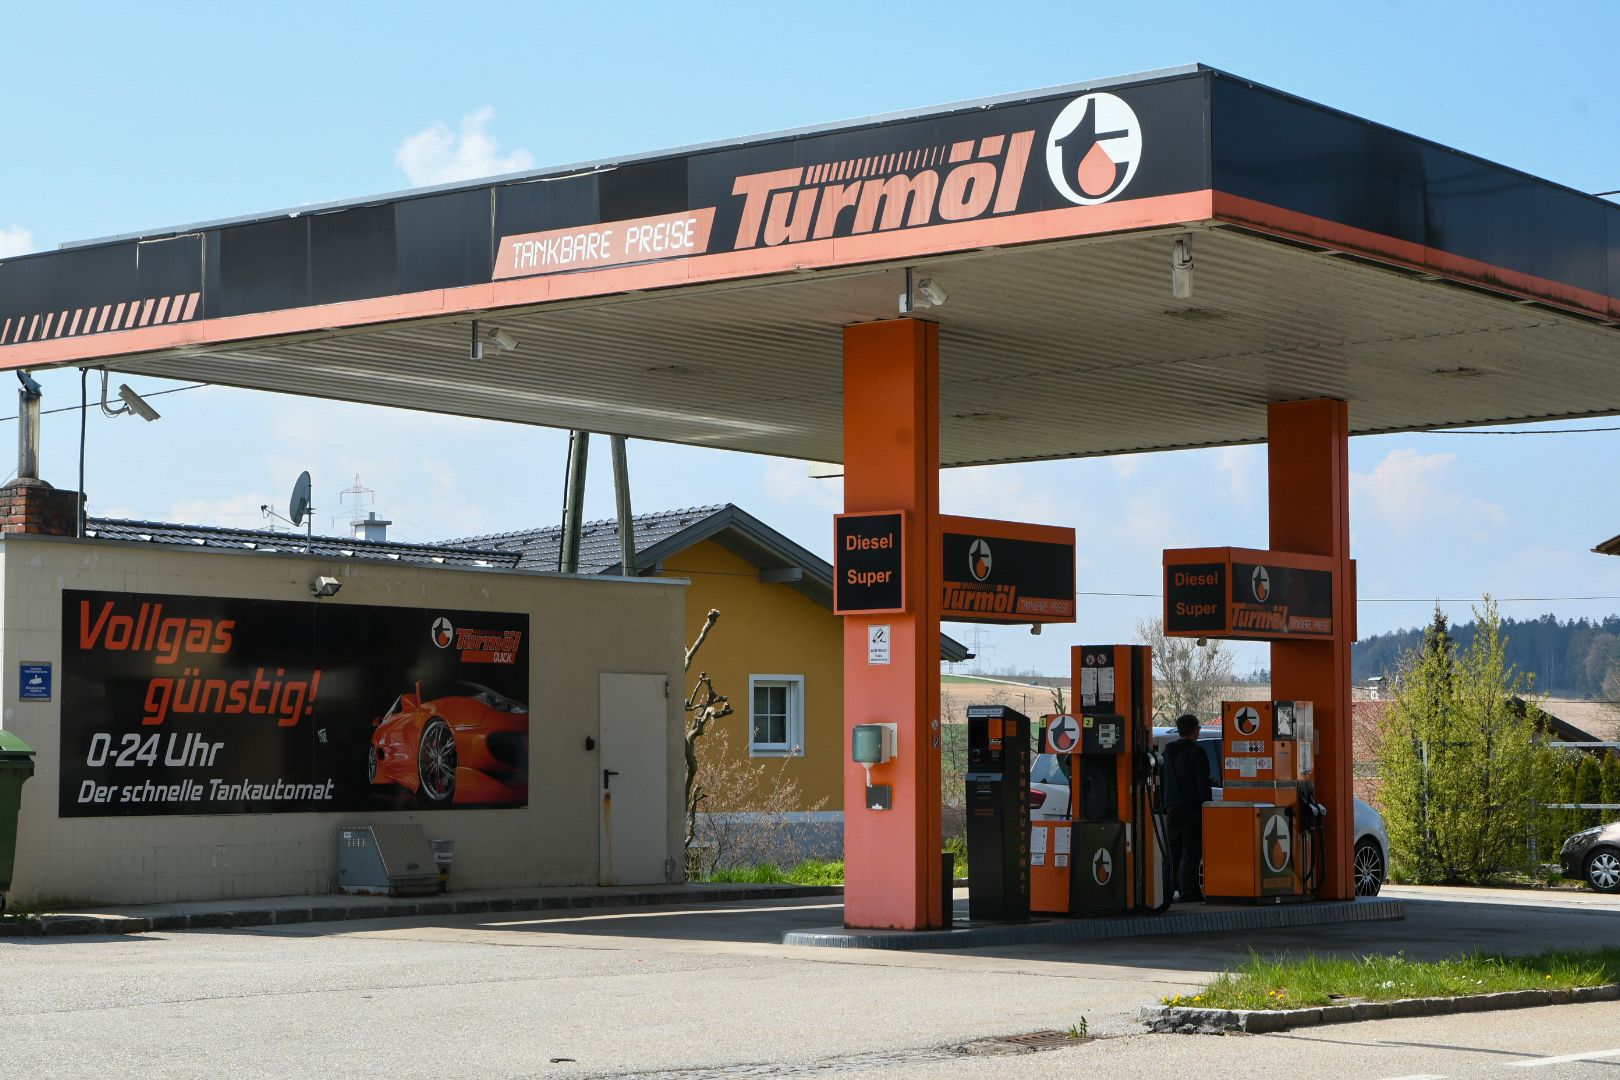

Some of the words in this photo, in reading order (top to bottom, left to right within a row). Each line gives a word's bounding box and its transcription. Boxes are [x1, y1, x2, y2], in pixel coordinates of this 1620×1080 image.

[731, 131, 1036, 250] Turmöl
[512, 230, 613, 269] TANKBARE
[624, 218, 697, 255] PREISE
[846, 532, 893, 551] Diesel
[847, 568, 892, 587] Super
[1174, 571, 1219, 587] Diesel
[943, 581, 1017, 613] Turmöl
[1176, 601, 1218, 617] Super
[1232, 602, 1288, 631] Turmöl
[79, 600, 236, 664] Vollgas
[456, 628, 521, 651] Turmöl
[142, 668, 323, 727] günstig!
[86, 732, 161, 768] 0-24
[164, 733, 224, 767] Uhr
[78, 780, 117, 803] Der
[120, 778, 204, 802] schnelle
[209, 778, 335, 801] Tankautomat
